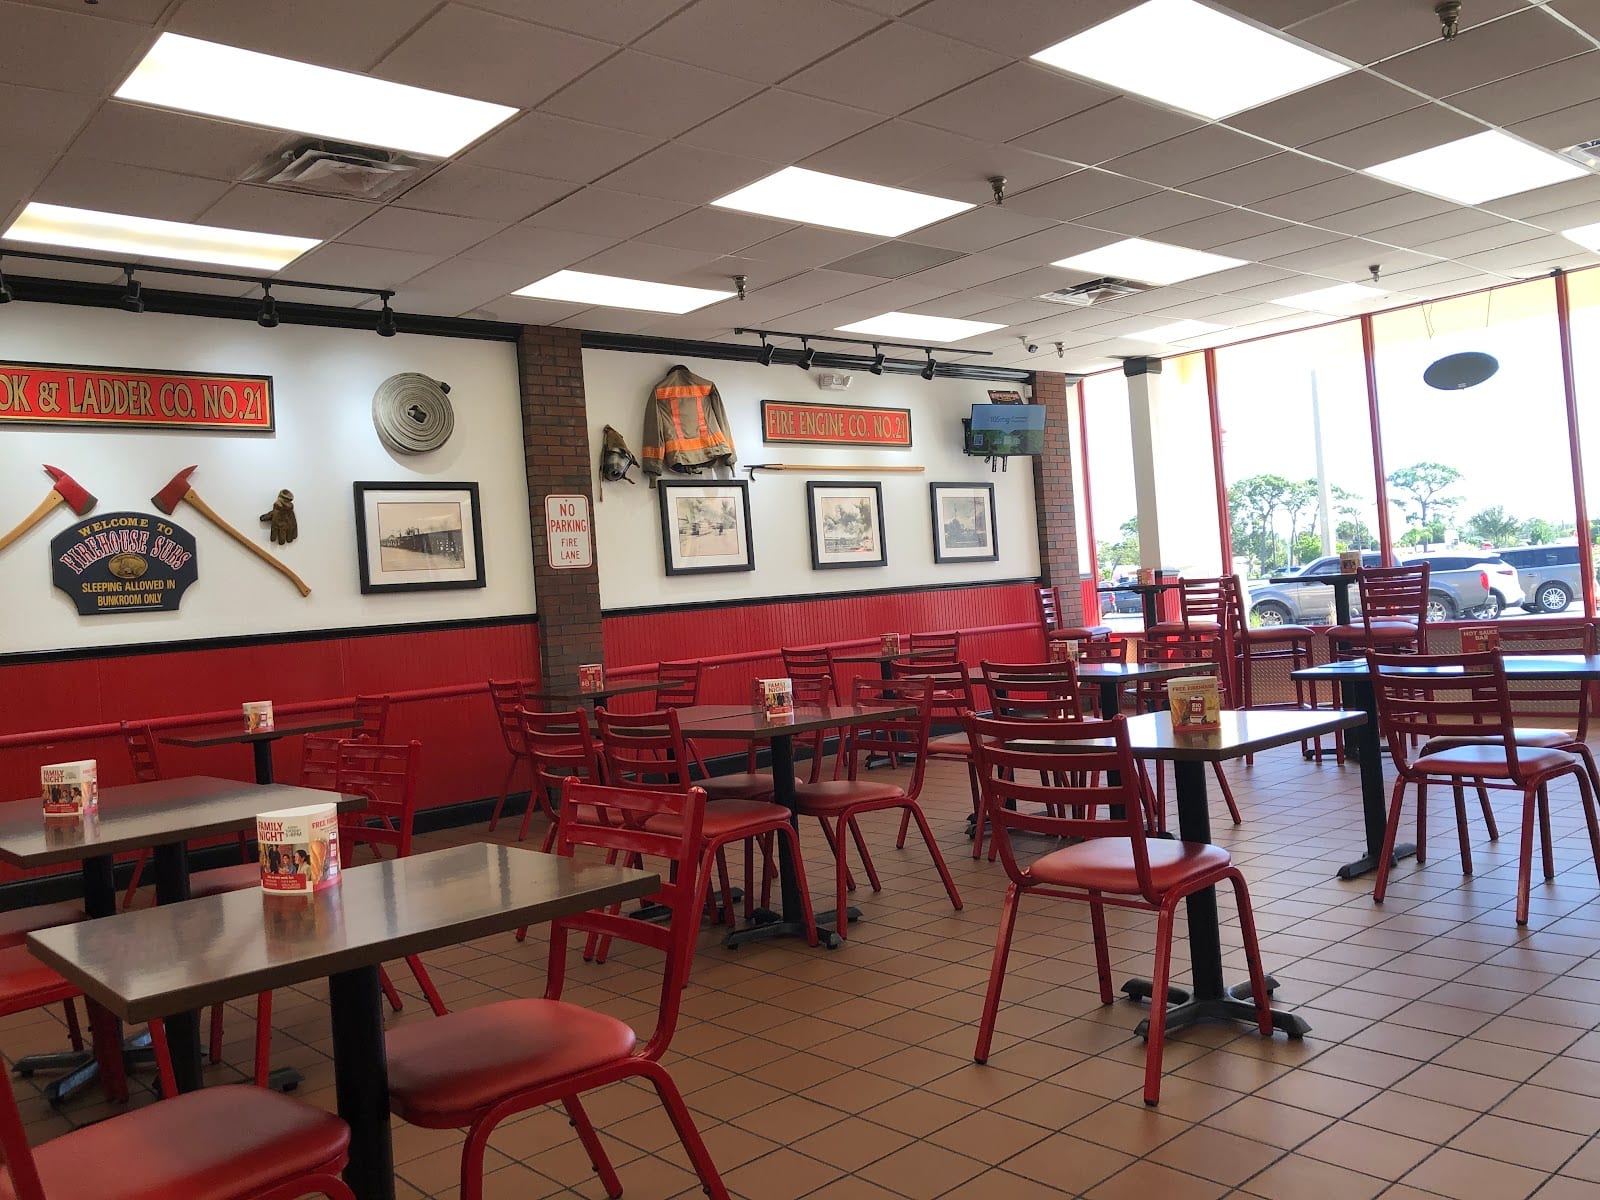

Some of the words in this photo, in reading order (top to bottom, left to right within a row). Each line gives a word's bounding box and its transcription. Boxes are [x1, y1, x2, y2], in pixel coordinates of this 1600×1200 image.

[67, 377, 154, 417] LADDER
[159, 382, 196, 418] CO.
[201, 384, 263, 420] NO.21
[768, 409, 796, 435] FIRE
[800, 411, 845, 437] ENGINE
[848, 414, 870, 437] CO.
[560, 503, 576, 517] NO
[78, 517, 149, 537] WELCOME
[157, 523, 173, 536] TO
[551, 519, 587, 532] PARKING
[561, 538, 578, 547] FIRE
[60, 529, 149, 575] FIREHOUSE
[150, 535, 192, 570] SUBS
[561, 551, 580, 560] LANE
[82, 582, 122, 593] SLEEPING
[125, 580, 164, 592] ALLOWED
[167, 579, 176, 589] IN
[97, 594, 142, 606] BUNKROOM
[144, 593, 162, 603] ONLY
[43, 769, 65, 777] FAMILY
[258, 821, 284, 832] FAMILY
[311, 821, 327, 830] FREE
[259, 831, 284, 842] NIGHT
